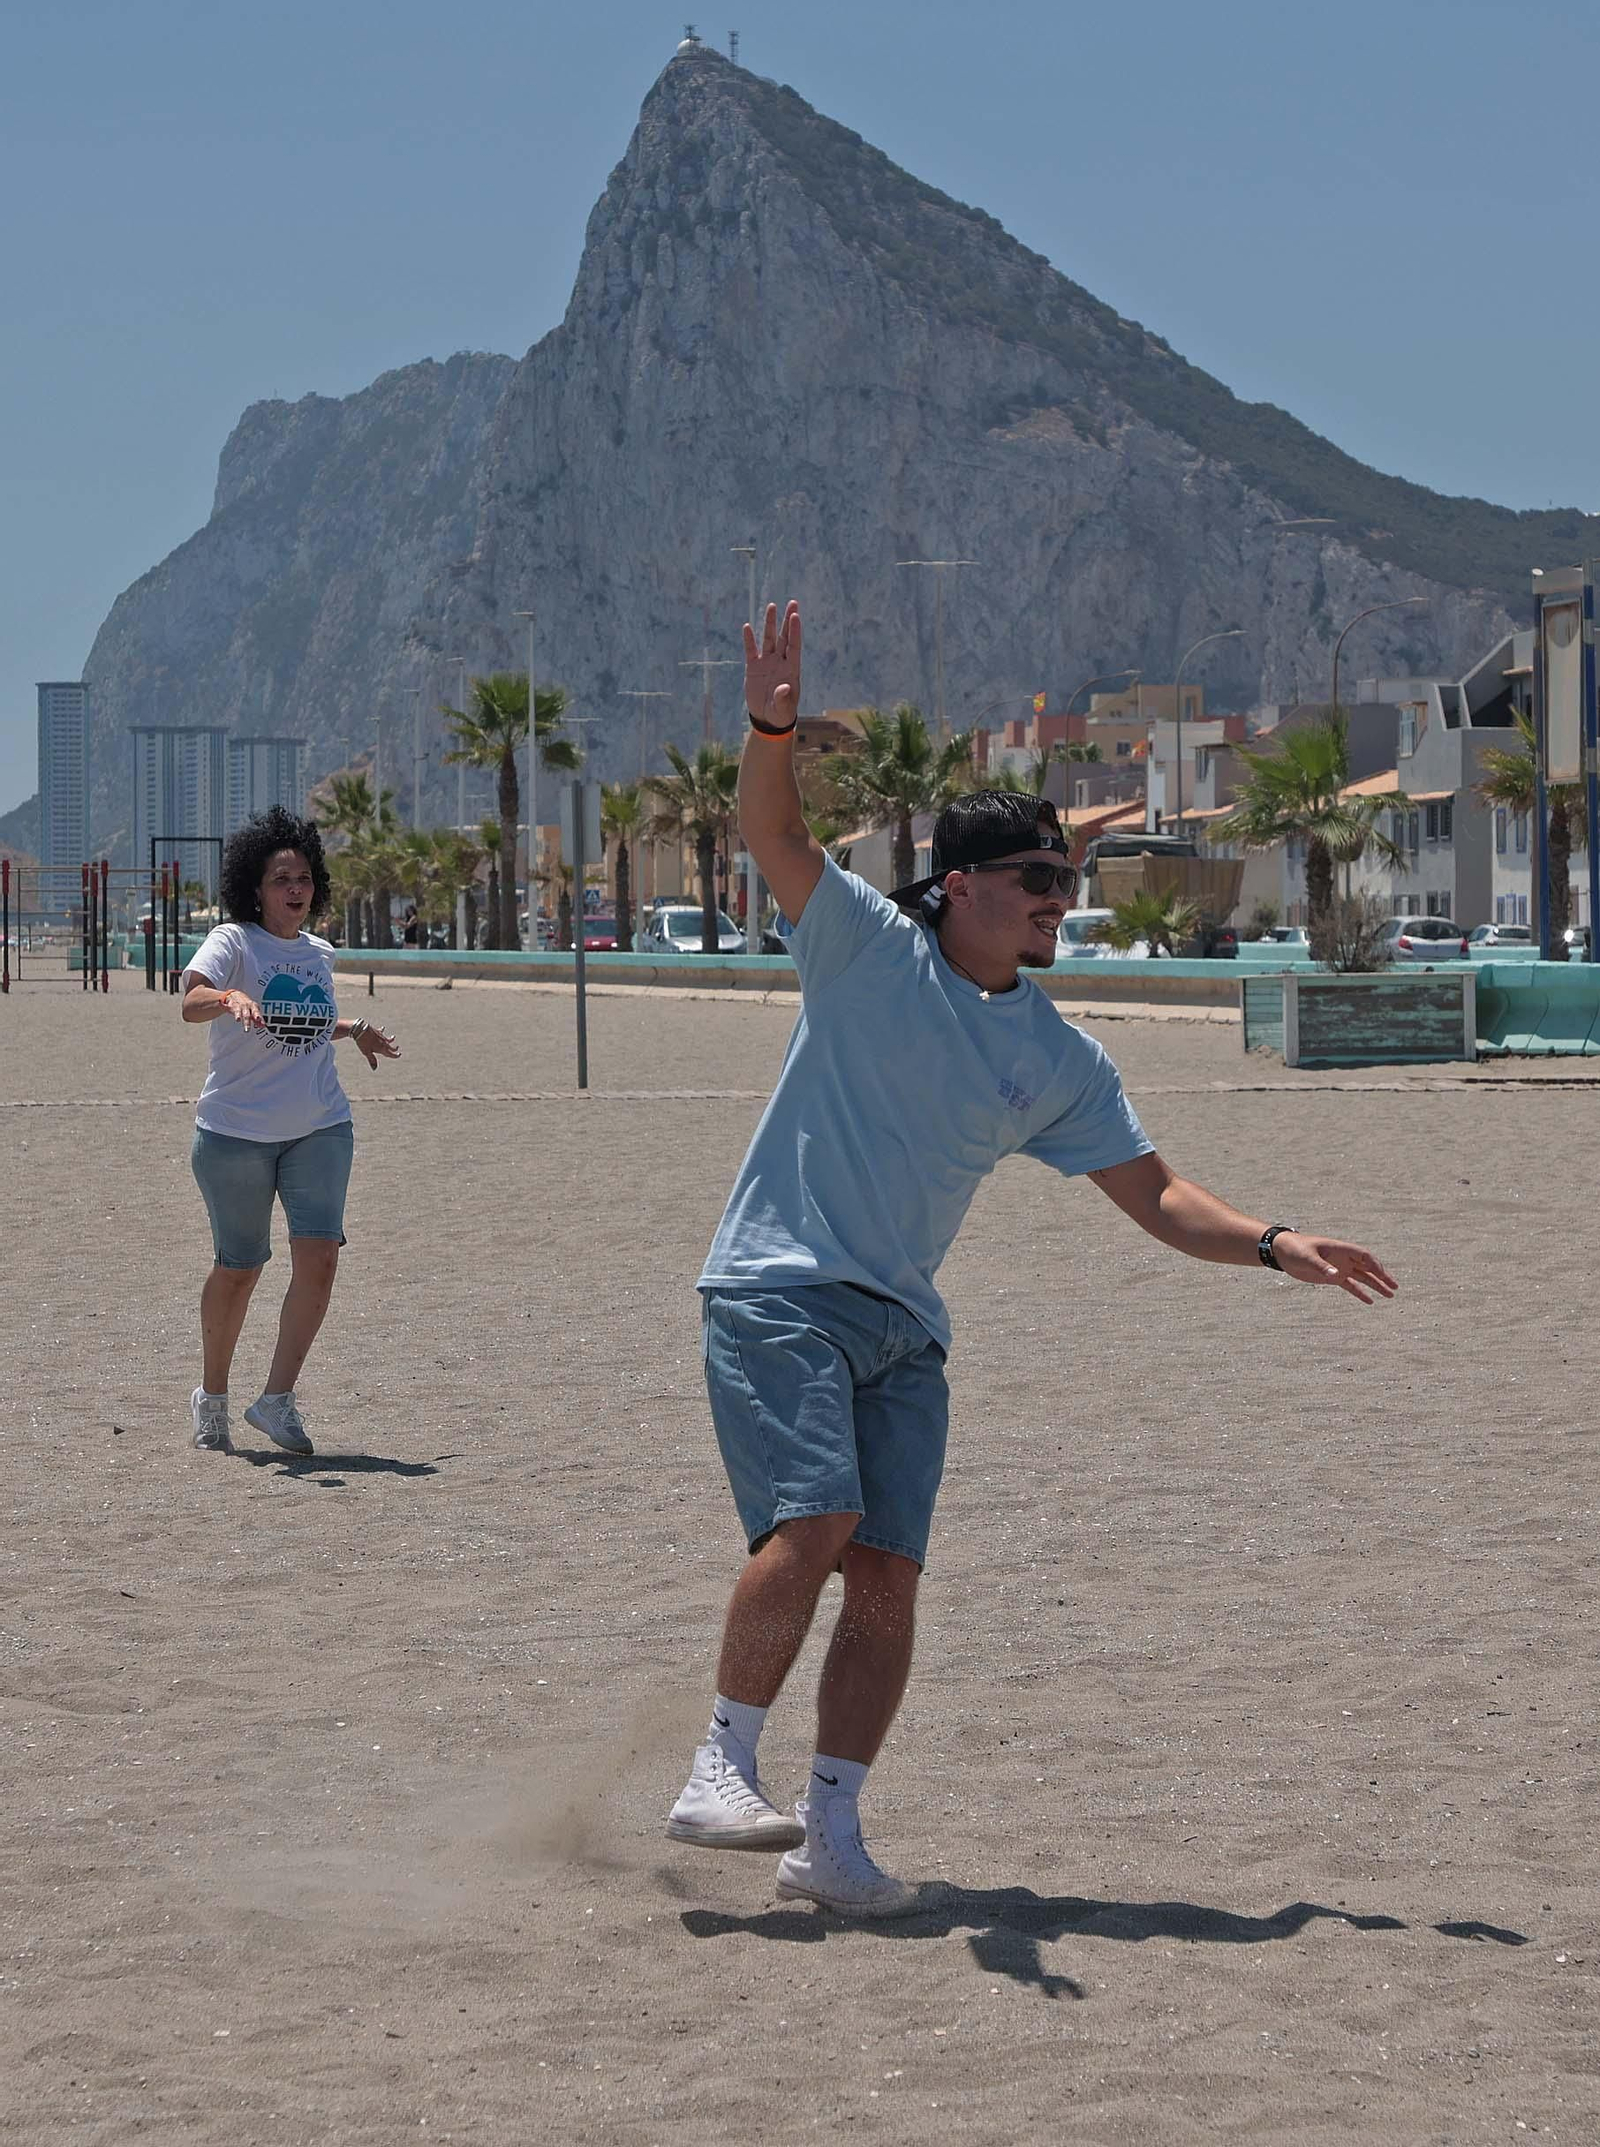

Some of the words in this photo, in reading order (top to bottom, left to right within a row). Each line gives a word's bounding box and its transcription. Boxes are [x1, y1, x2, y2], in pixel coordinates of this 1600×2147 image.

[285, 963, 301, 975] THE
[262, 1002, 292, 1016] THE
[295, 1003, 334, 1018] WAVE
[280, 1044, 301, 1057] THE
